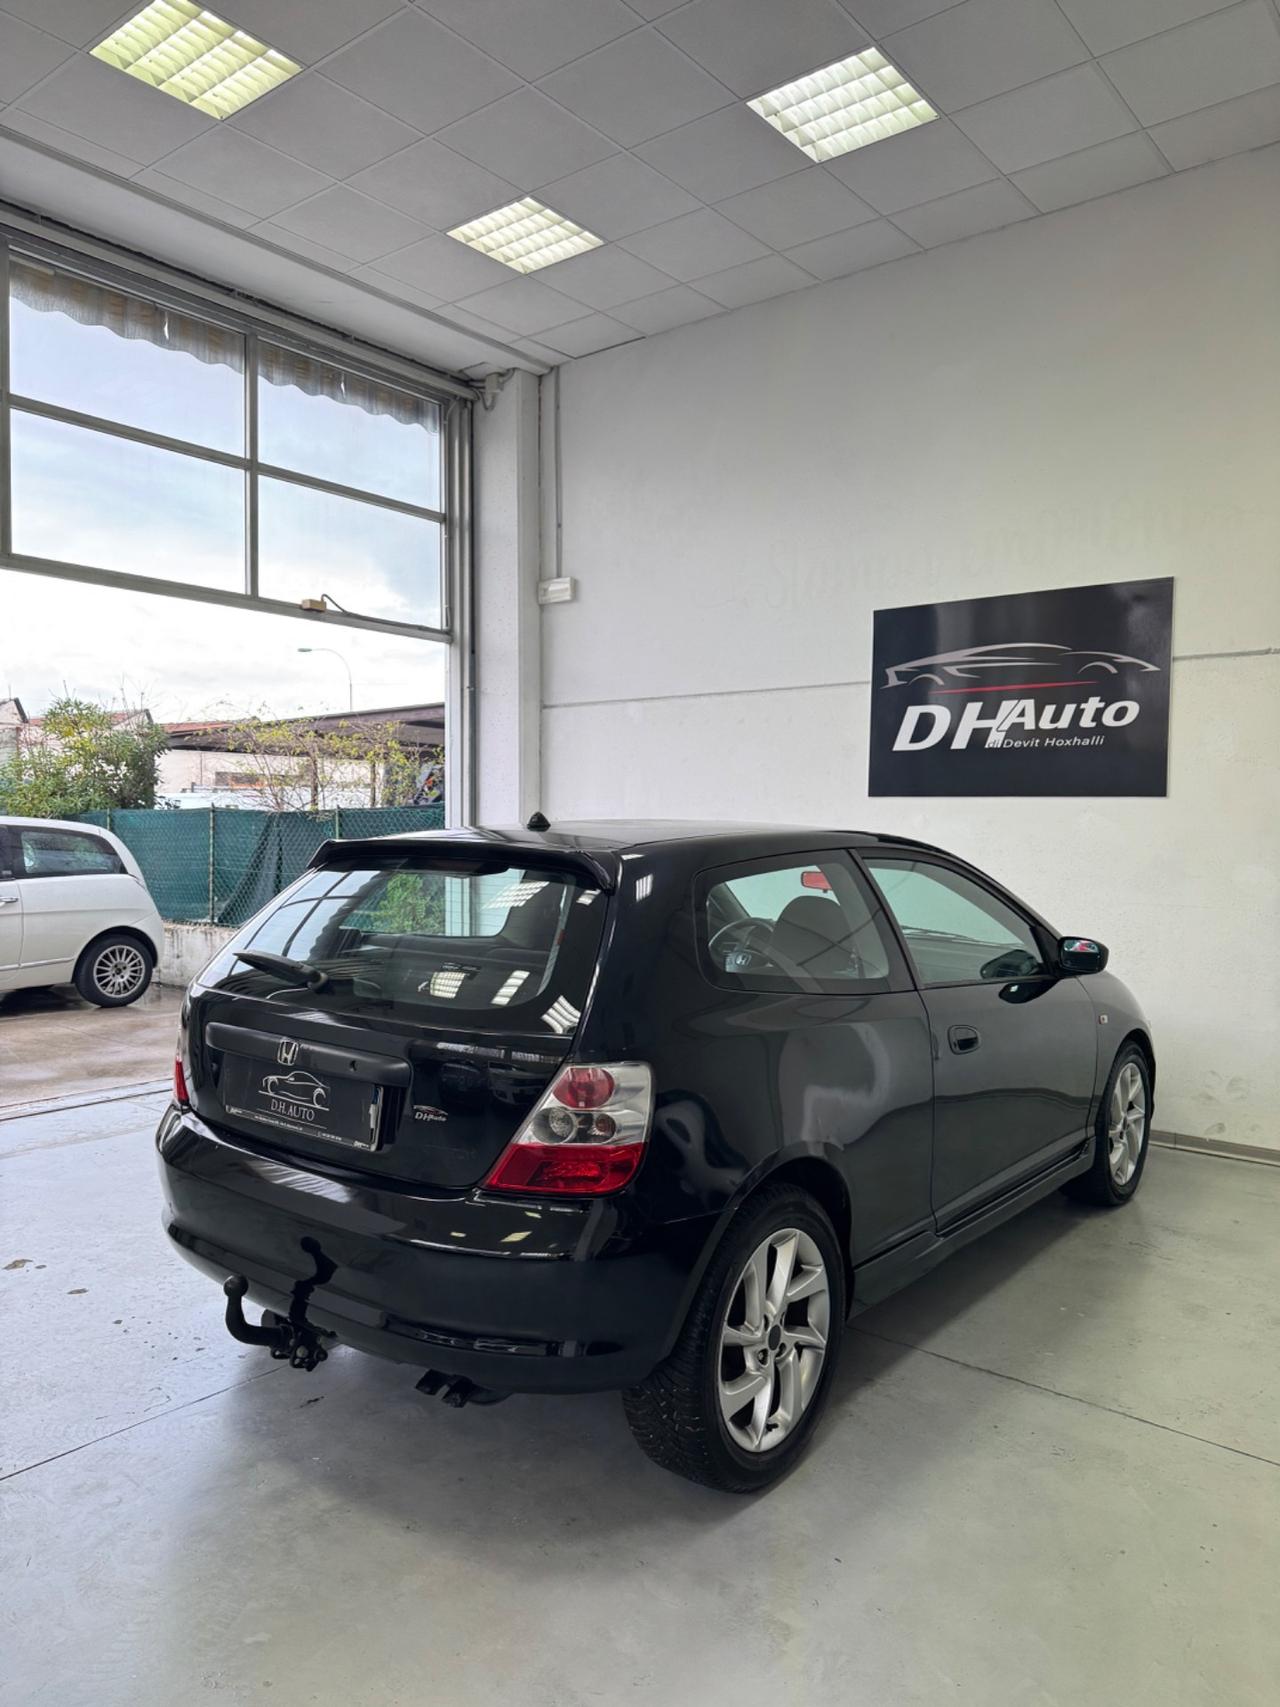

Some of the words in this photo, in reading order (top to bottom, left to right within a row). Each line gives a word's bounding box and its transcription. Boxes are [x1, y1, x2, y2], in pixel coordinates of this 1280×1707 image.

[1003, 738, 1040, 748] Devit
[1044, 735, 1105, 747] Hoxhalli
[287, 1105, 315, 1121] AUTO
